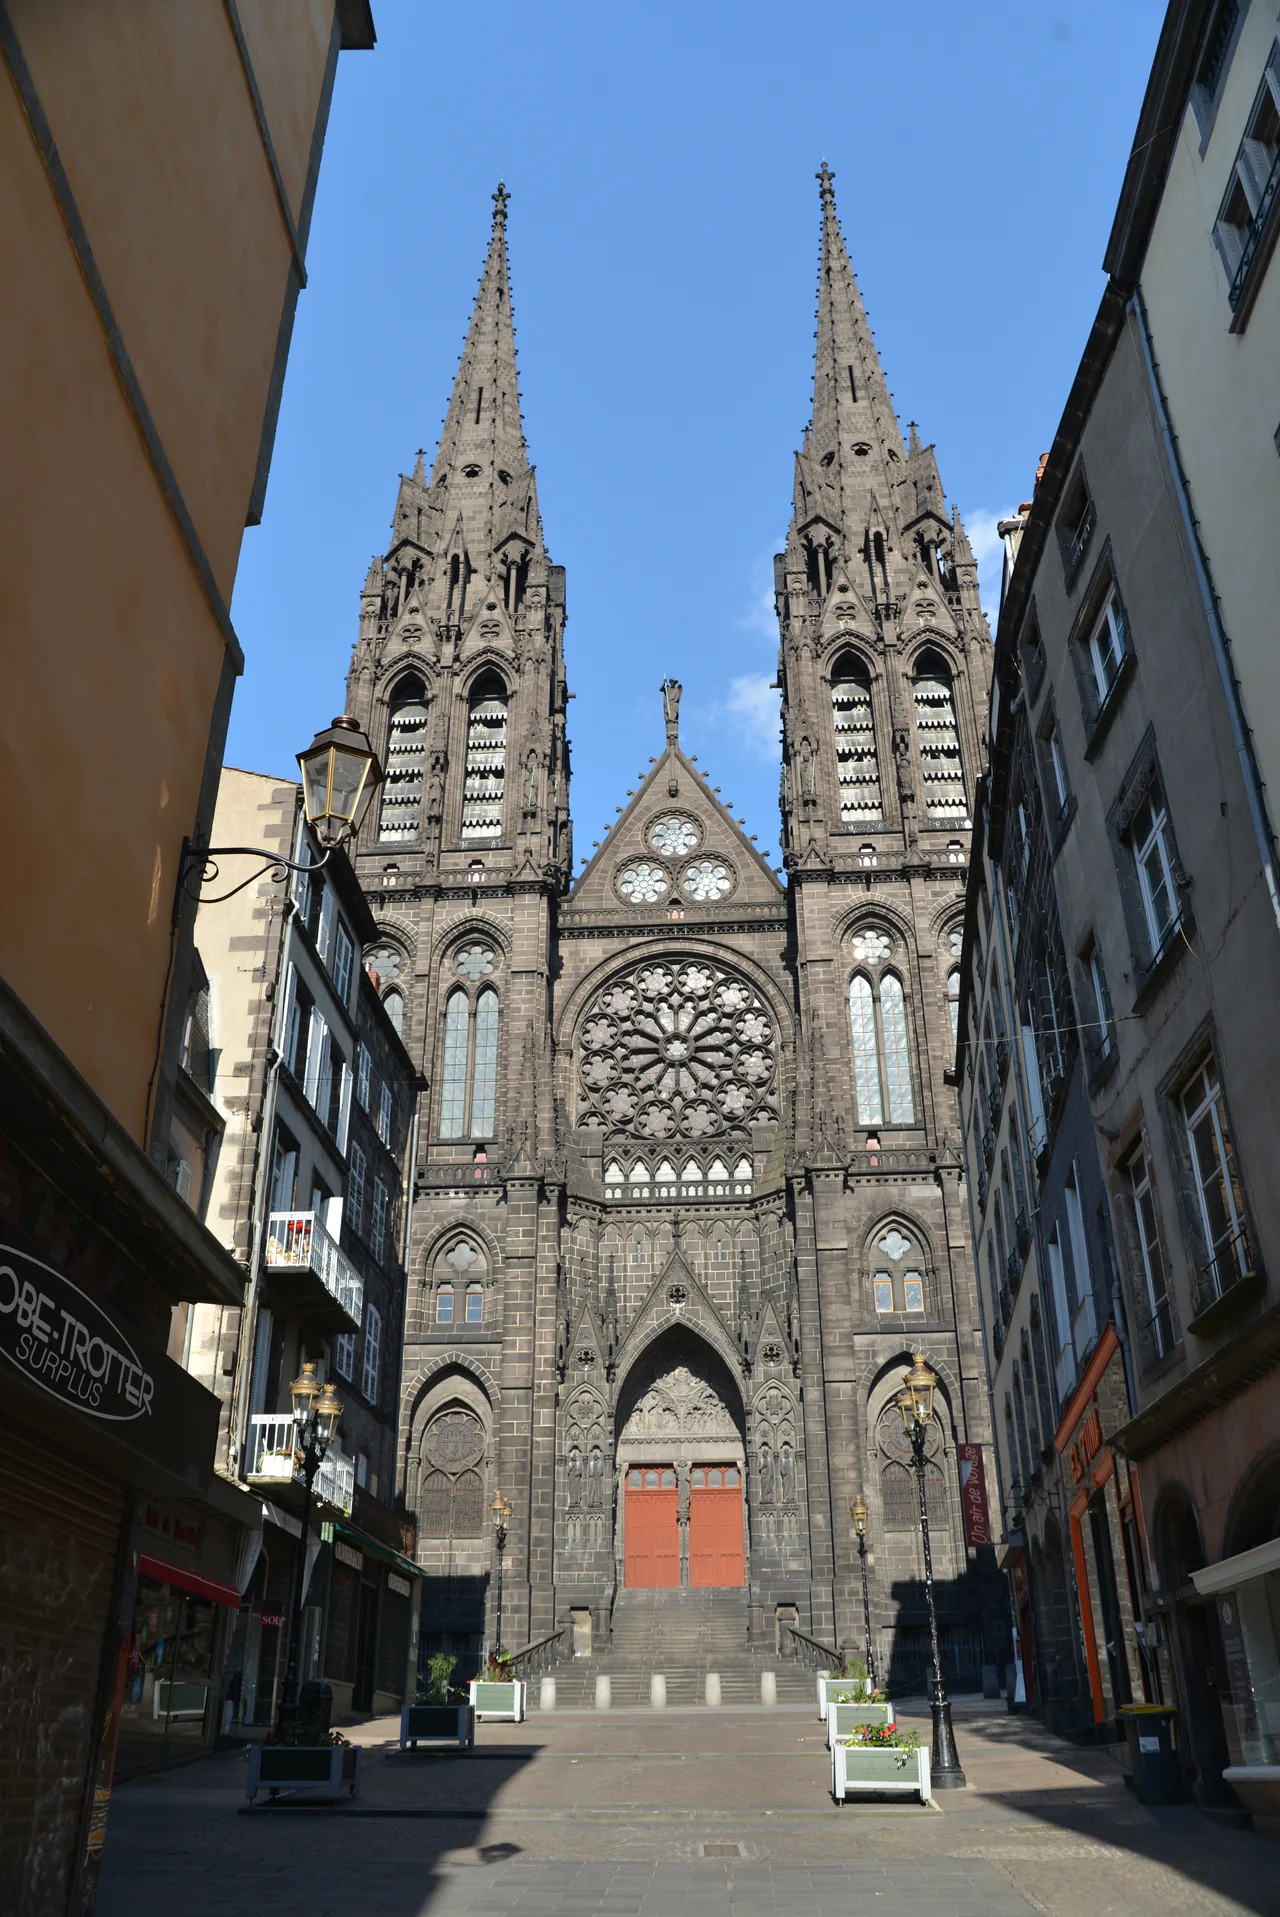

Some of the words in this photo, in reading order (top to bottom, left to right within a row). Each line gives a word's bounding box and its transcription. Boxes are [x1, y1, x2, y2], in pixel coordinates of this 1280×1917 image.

[16, 1333, 103, 1407] SURPLUS
[965, 1446, 980, 1485] voyage
[968, 1488, 982, 1504] de
[970, 1505, 985, 1523] air
[971, 1525, 987, 1544] Un
